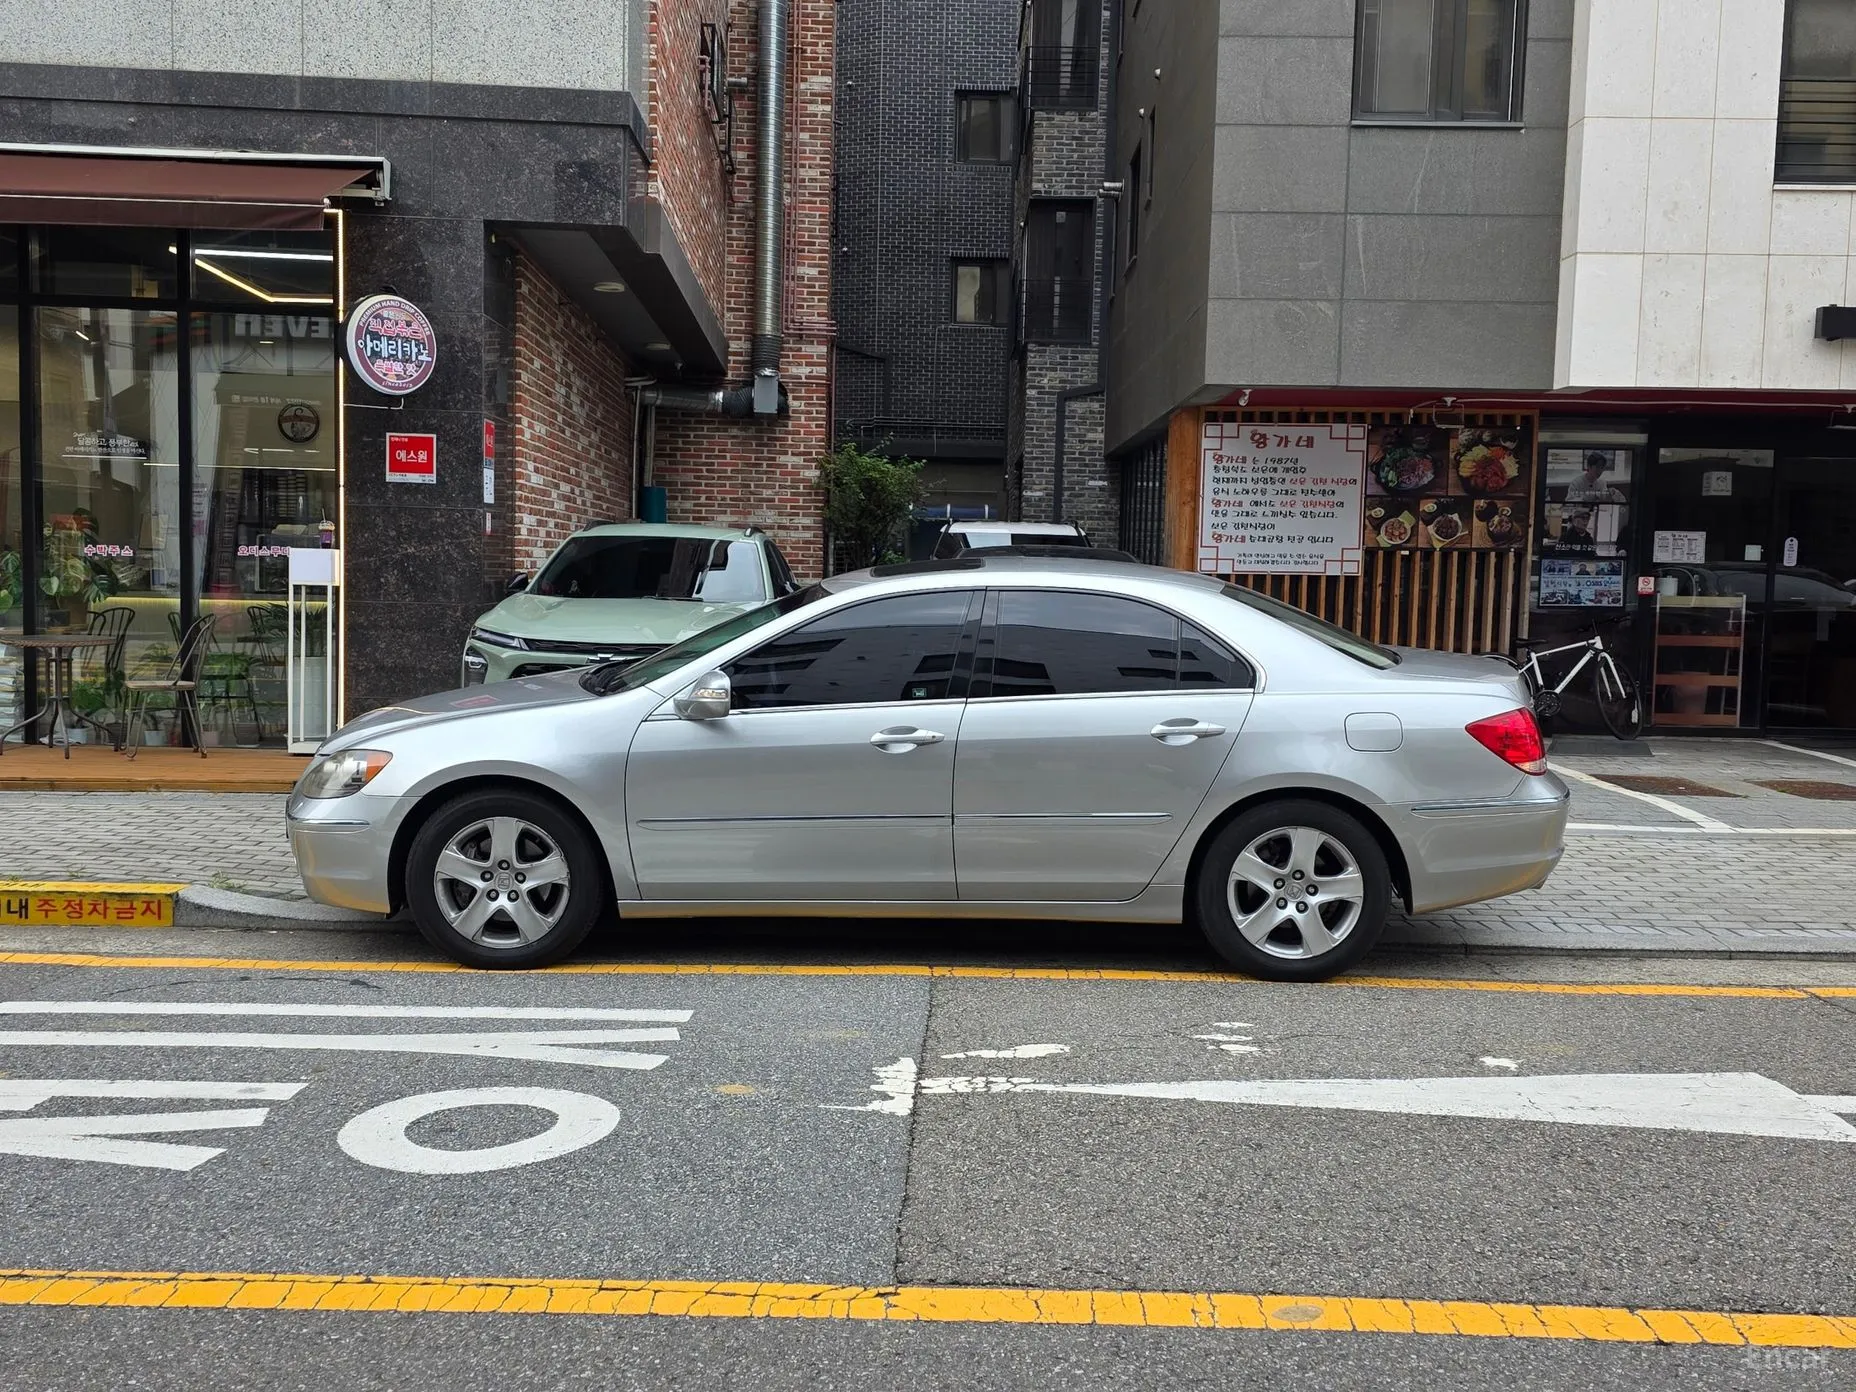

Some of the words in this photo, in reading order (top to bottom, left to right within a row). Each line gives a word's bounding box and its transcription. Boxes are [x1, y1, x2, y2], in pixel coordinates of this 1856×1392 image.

[358, 334, 432, 362] 아메리카노
[1249, 429, 1314, 449] 왕가네
[396, 450, 427, 462] 에스원
[84, 545, 133, 556] 수박주스
[0, 898, 28, 919] 내
[36, 898, 162, 920] 주정차금지
